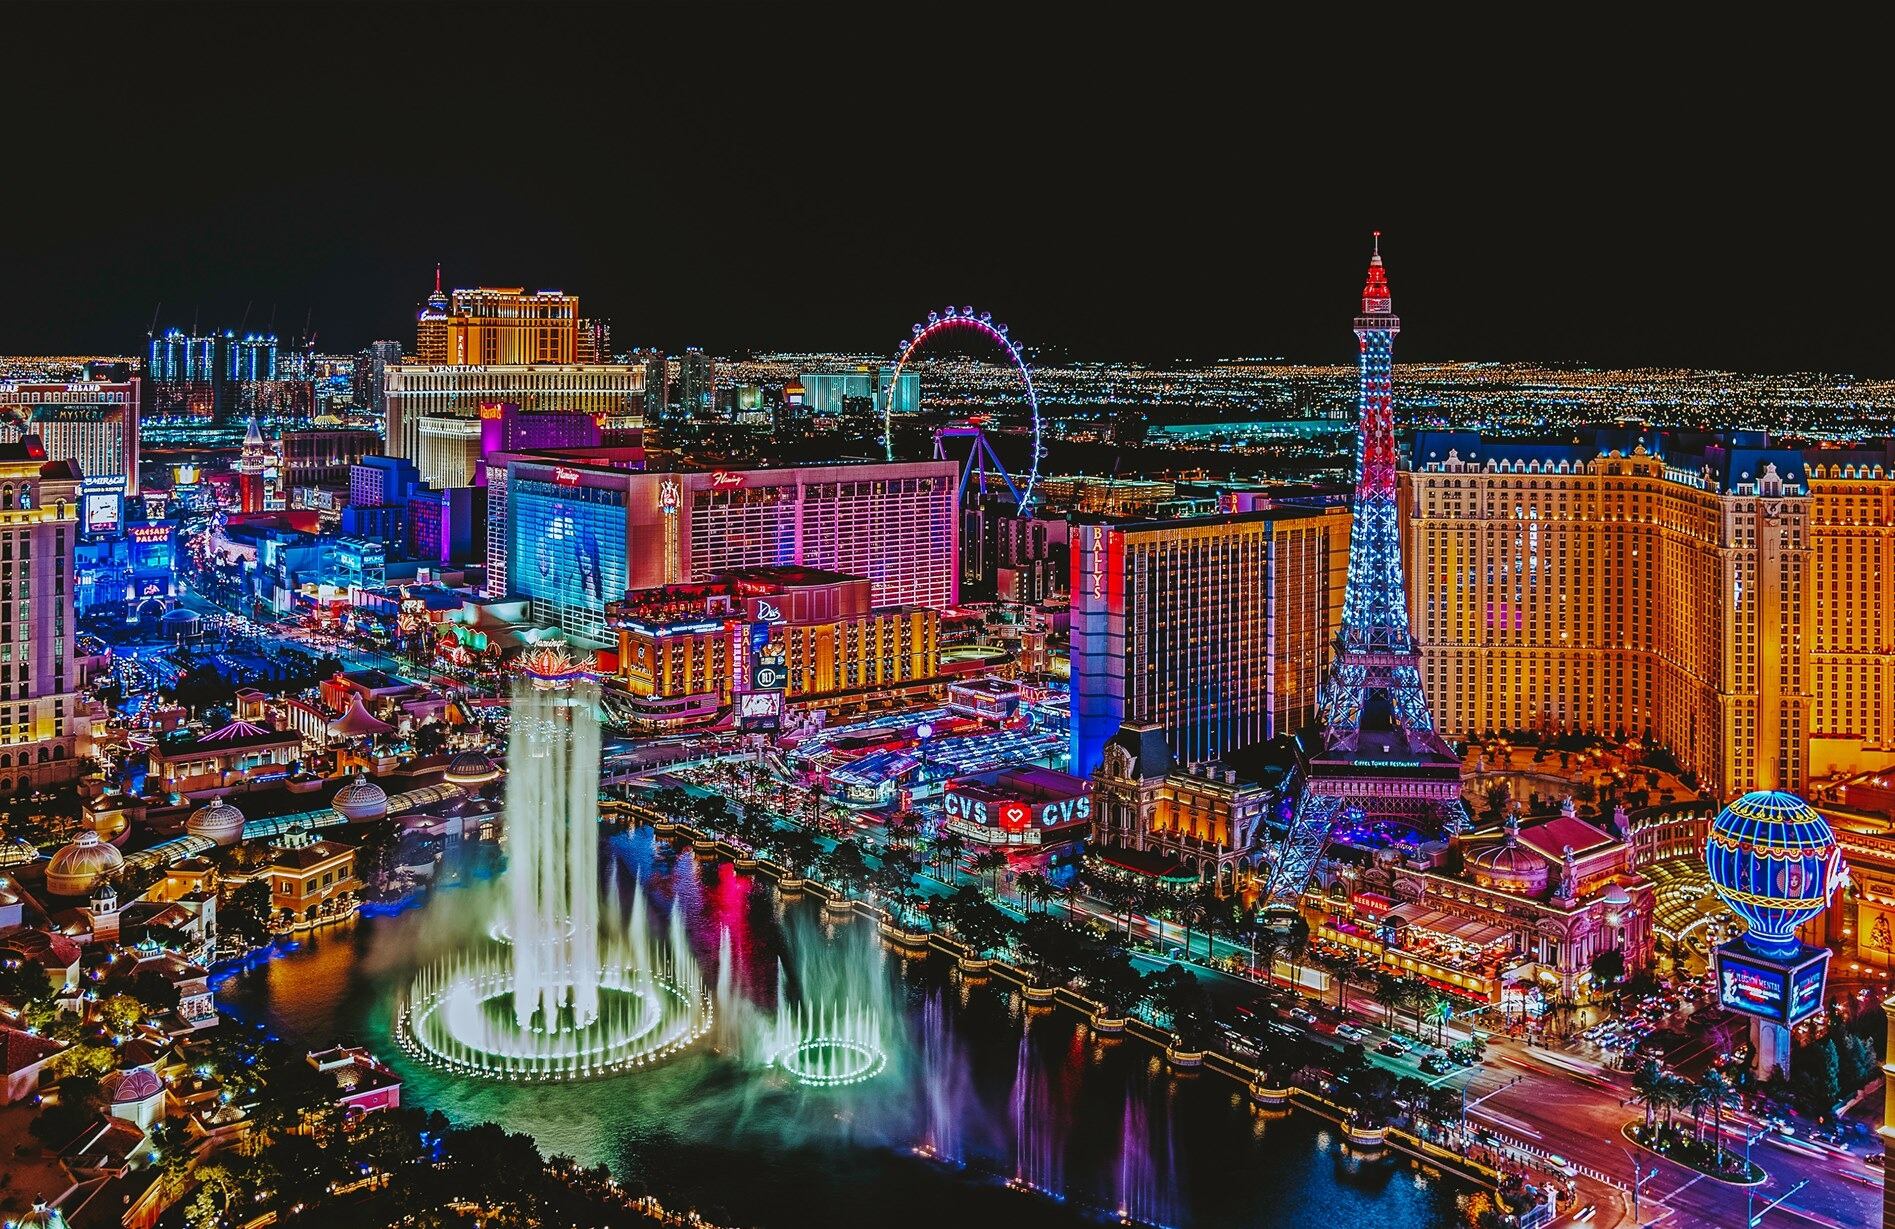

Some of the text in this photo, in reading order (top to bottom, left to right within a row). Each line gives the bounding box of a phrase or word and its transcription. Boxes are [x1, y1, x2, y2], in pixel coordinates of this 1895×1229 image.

[432, 364, 486, 373] VENETIAN
[134, 527, 170, 536] CAESARS
[944, 793, 988, 825] CVS
[1042, 795, 1092, 827] CVS
[1354, 895, 1388, 912] BEER PARK
